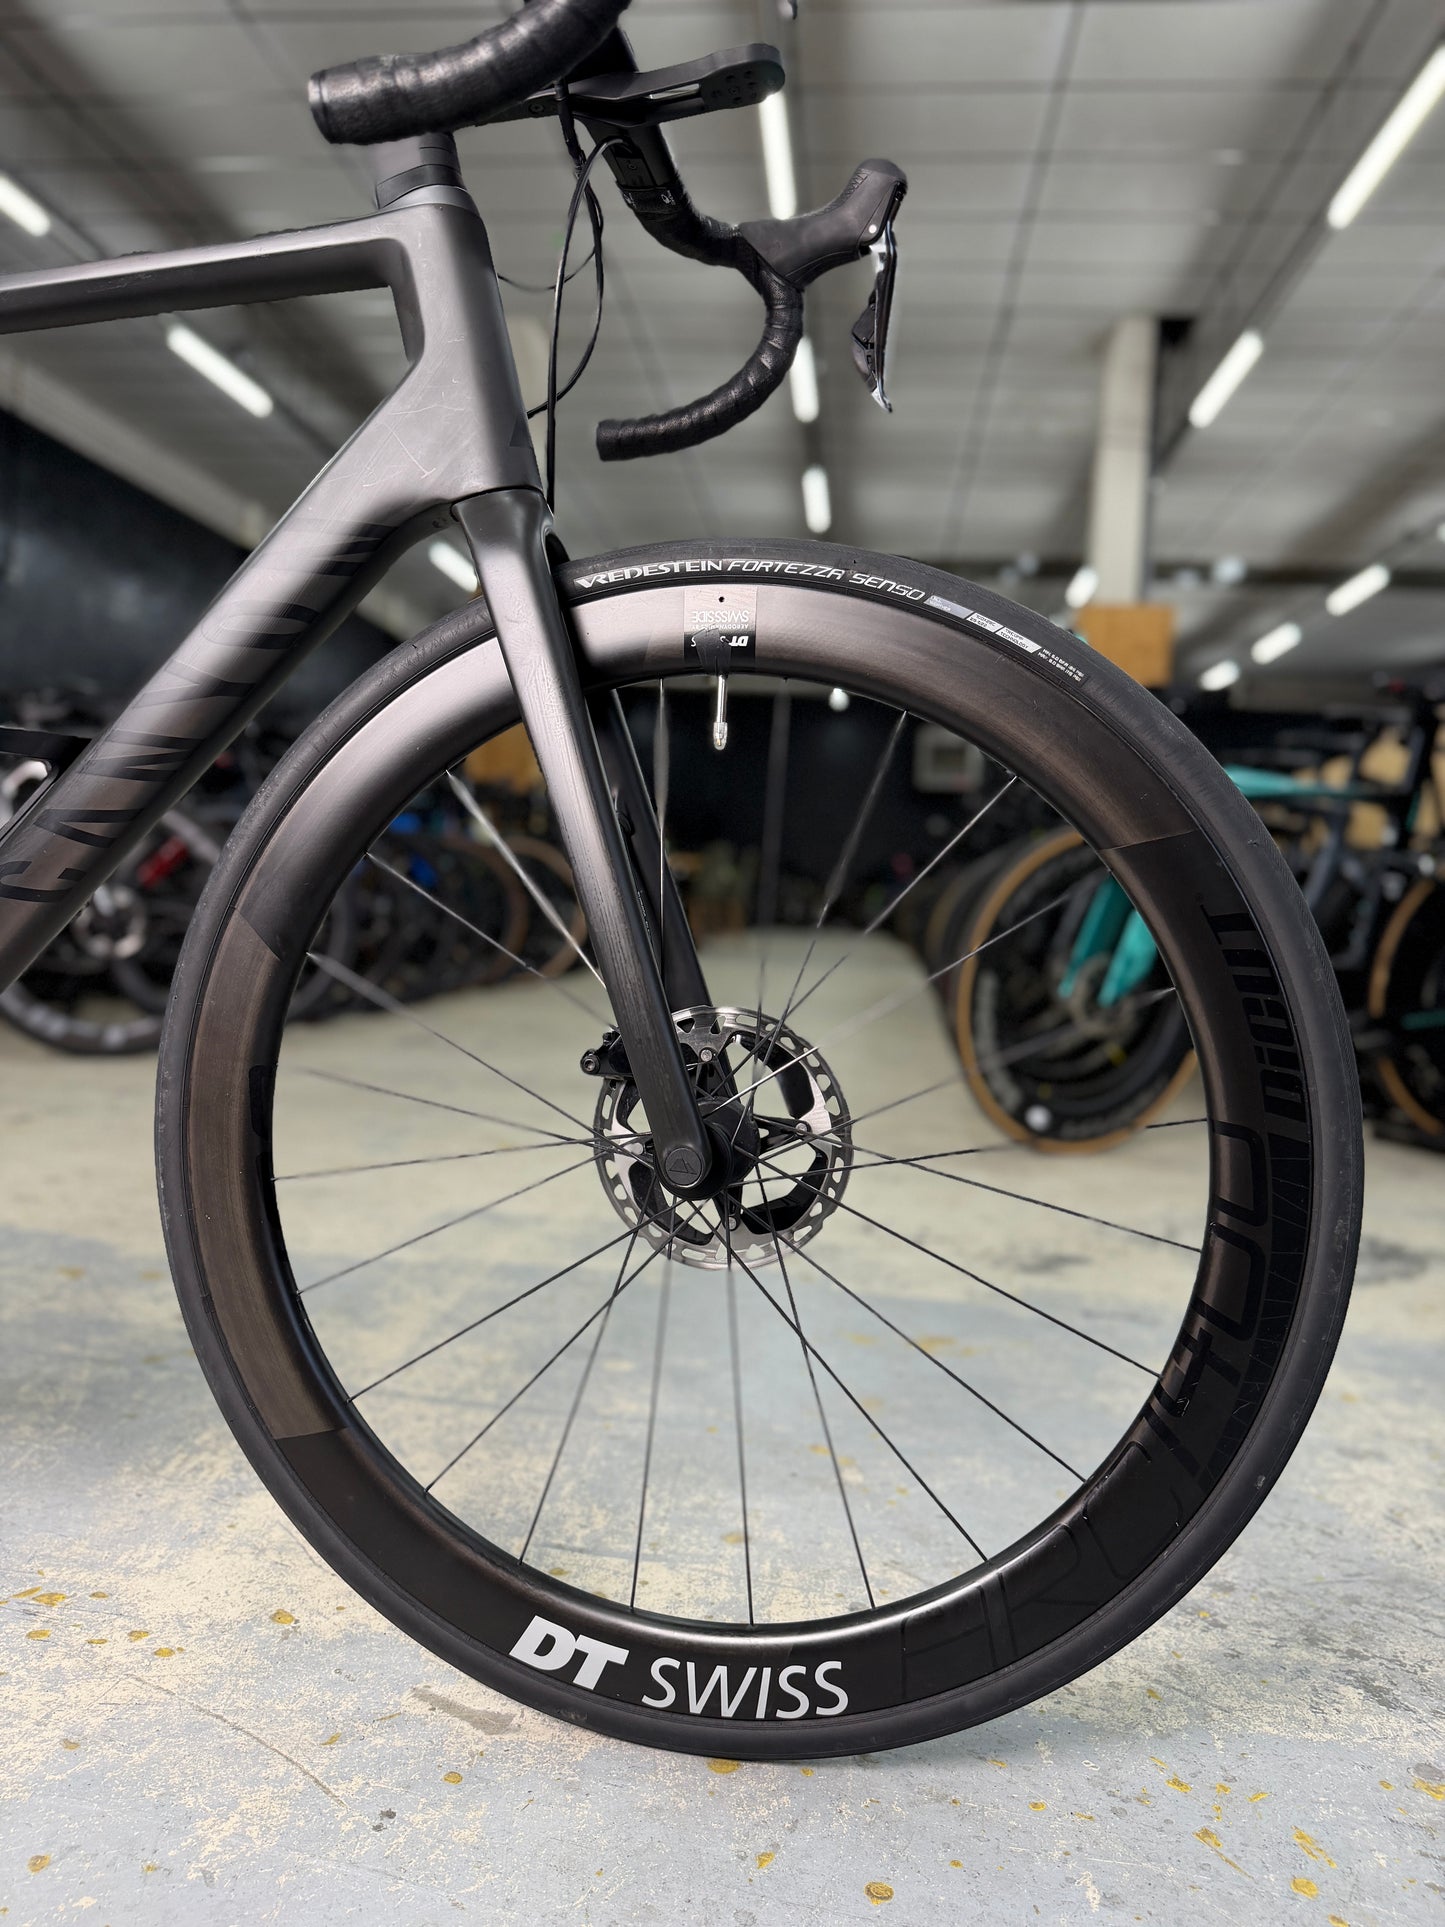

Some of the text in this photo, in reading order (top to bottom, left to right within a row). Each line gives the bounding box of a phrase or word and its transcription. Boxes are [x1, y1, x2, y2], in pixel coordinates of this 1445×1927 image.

[575, 559, 926, 601] VREDESTEIN FORTEZZA SENSO
[507, 1614, 850, 1720] DT SWISS
